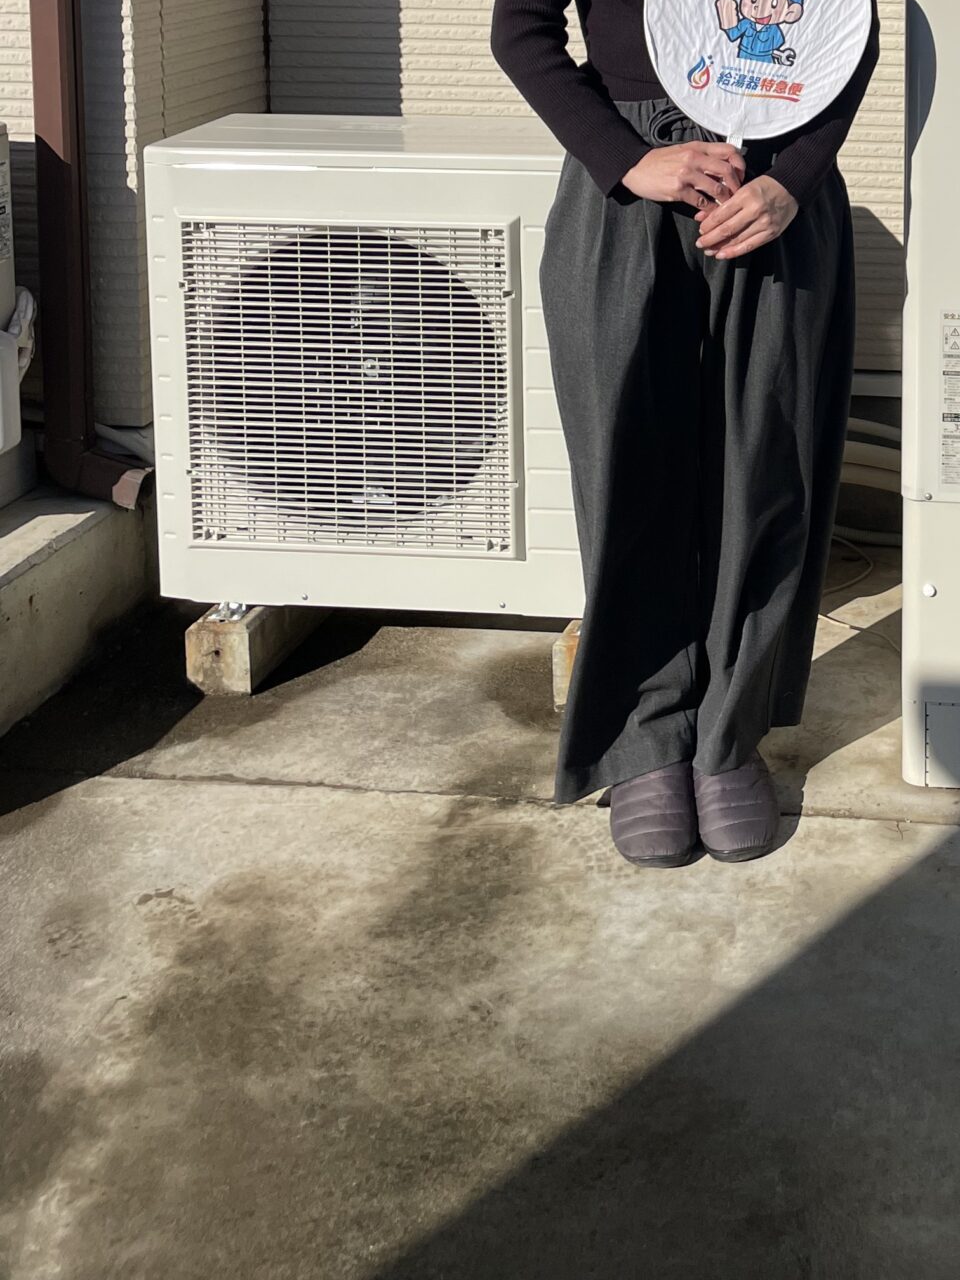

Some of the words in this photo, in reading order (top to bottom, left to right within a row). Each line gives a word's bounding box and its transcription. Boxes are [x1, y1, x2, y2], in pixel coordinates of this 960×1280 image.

[717, 71, 805, 96] 給湯器特急便
